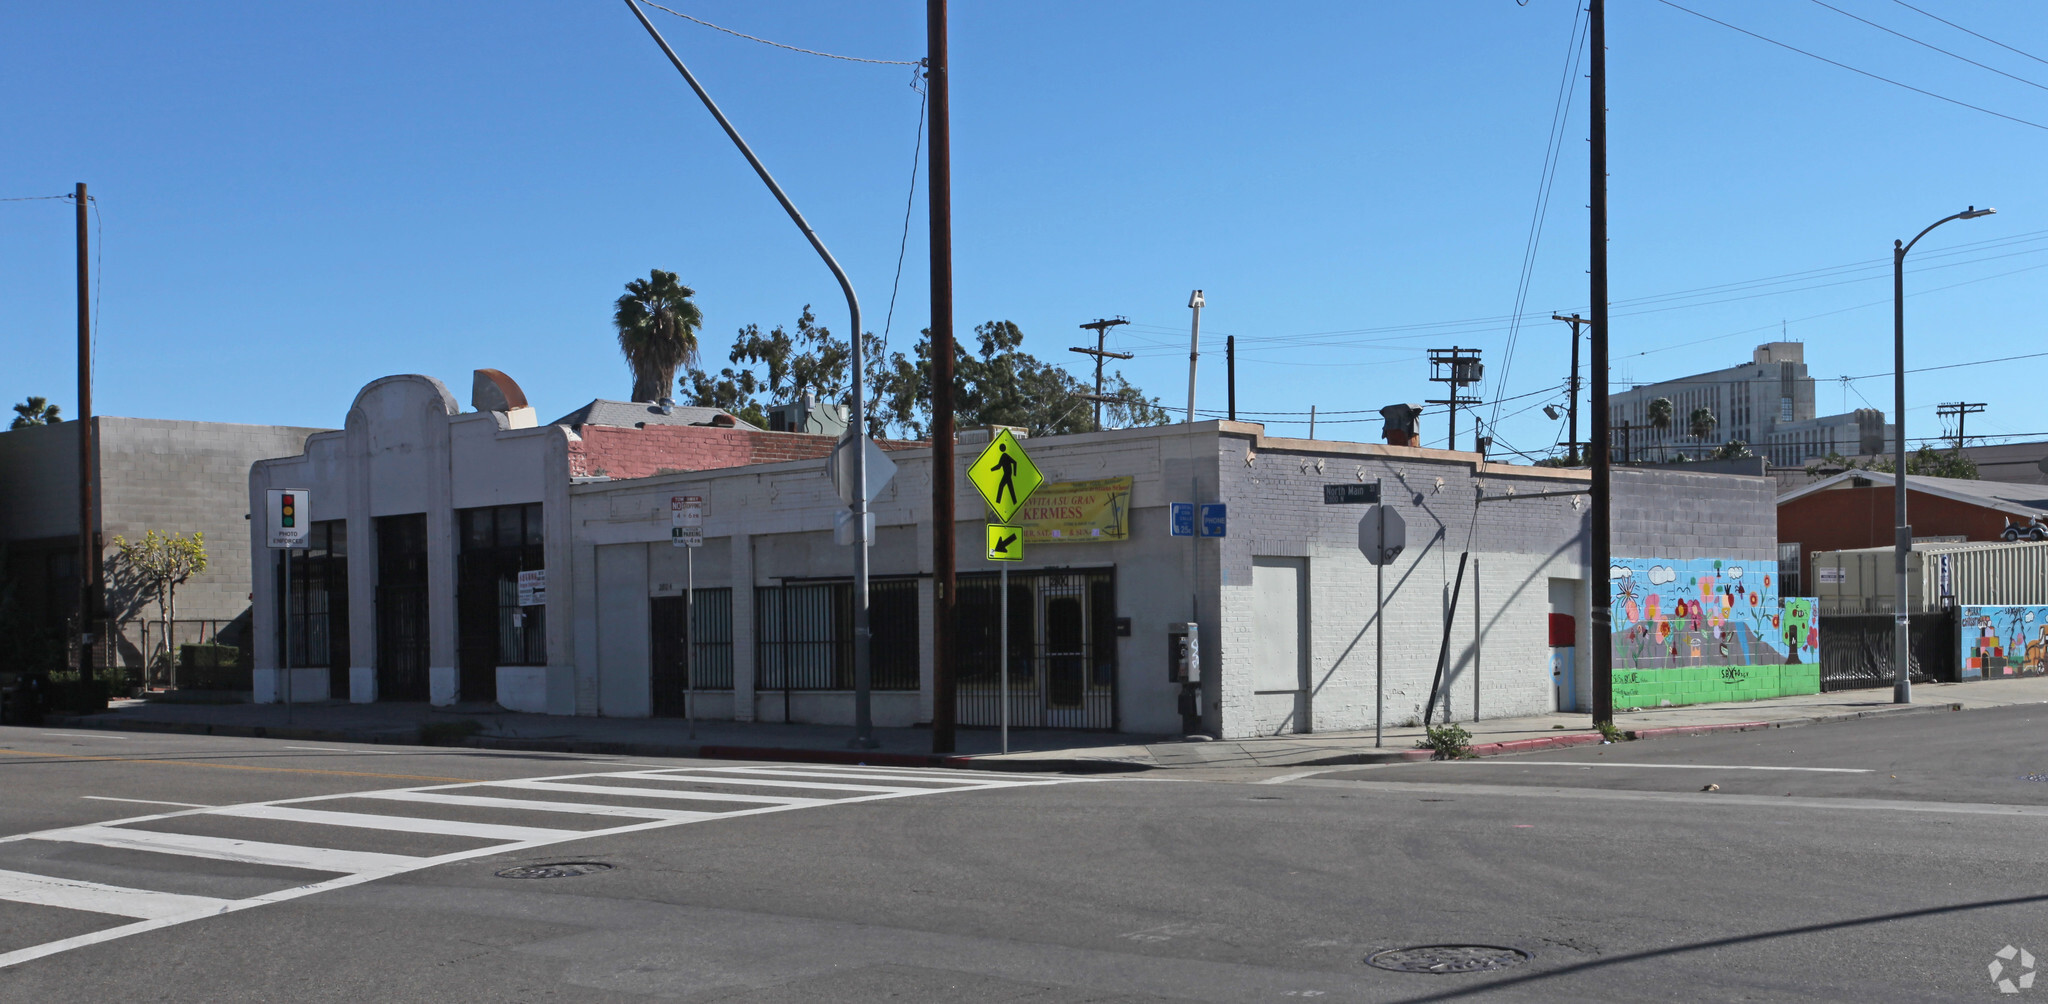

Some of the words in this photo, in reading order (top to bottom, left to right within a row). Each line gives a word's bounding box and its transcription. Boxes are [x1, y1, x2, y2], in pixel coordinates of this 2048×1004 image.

[1326, 486, 1346, 496] North
[1348, 485, 1364, 496] Main
[1059, 496, 1069, 505] SU
[1071, 495, 1096, 505] GRAN
[672, 502, 682, 510] NO
[1023, 506, 1083, 521] KERMESS
